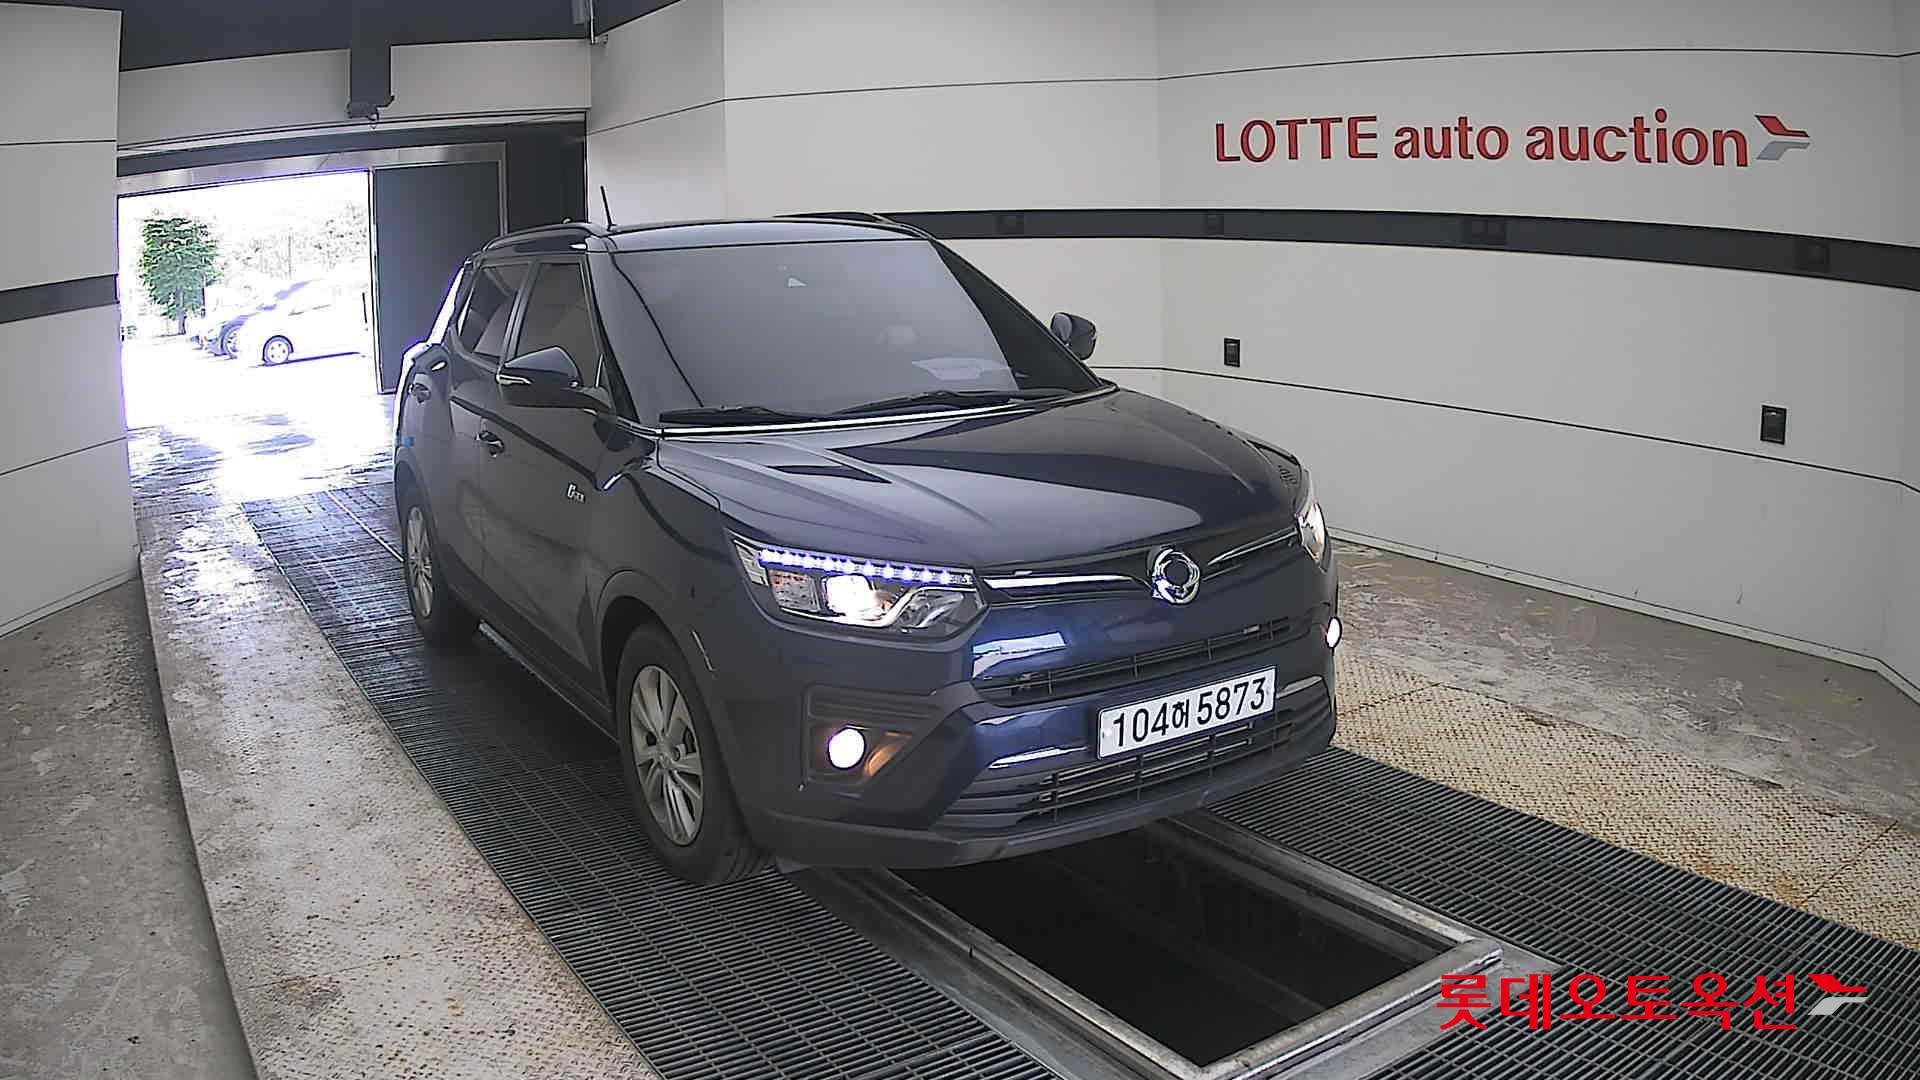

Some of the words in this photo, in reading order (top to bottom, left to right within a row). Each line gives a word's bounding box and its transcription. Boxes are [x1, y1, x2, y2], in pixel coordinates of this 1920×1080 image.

[1215, 116, 1379, 162] LOTTE
[1393, 116, 1510, 161] auto
[1525, 108, 1749, 167] auction
